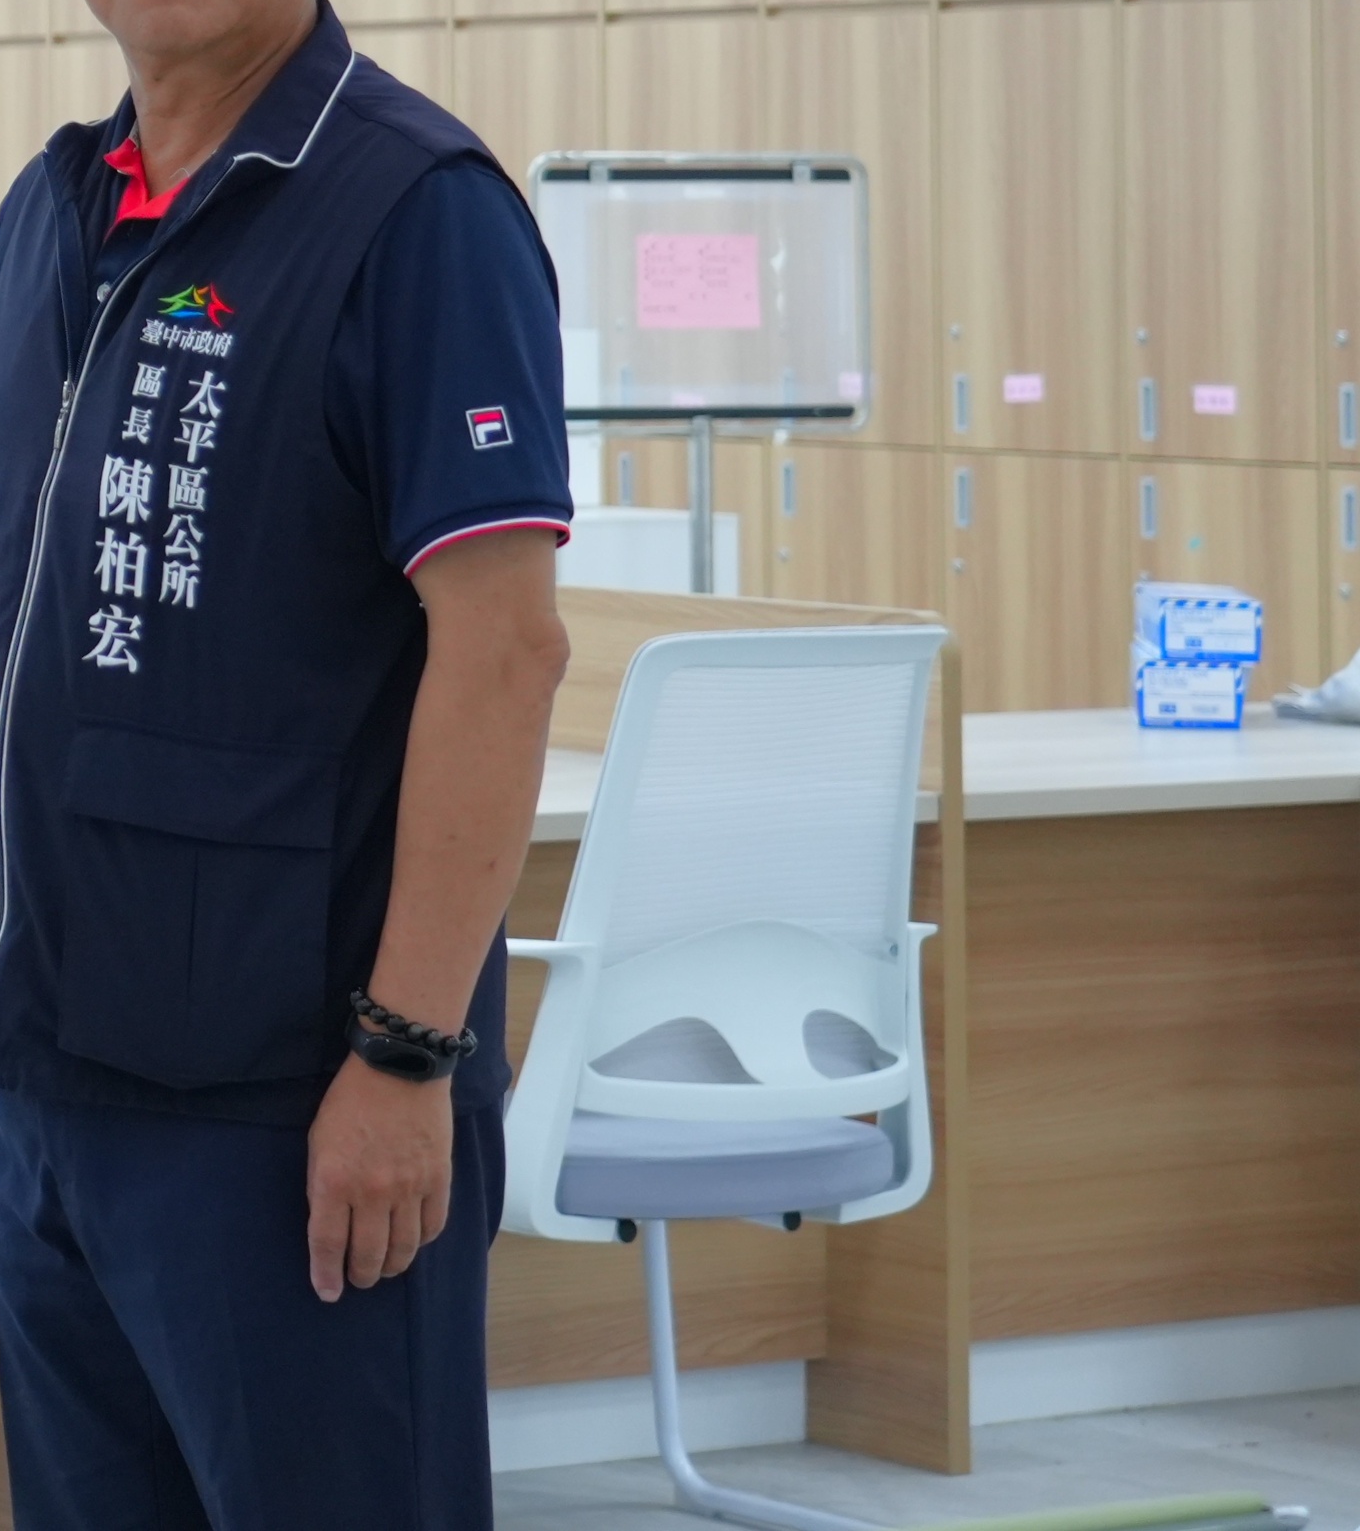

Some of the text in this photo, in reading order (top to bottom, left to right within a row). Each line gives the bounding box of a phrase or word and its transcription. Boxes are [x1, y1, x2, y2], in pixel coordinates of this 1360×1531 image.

[139, 318, 234, 358] 臺中市政府
[81, 362, 167, 674] 區長 陳柏宏
[158, 370, 227, 609] 太平區公所
